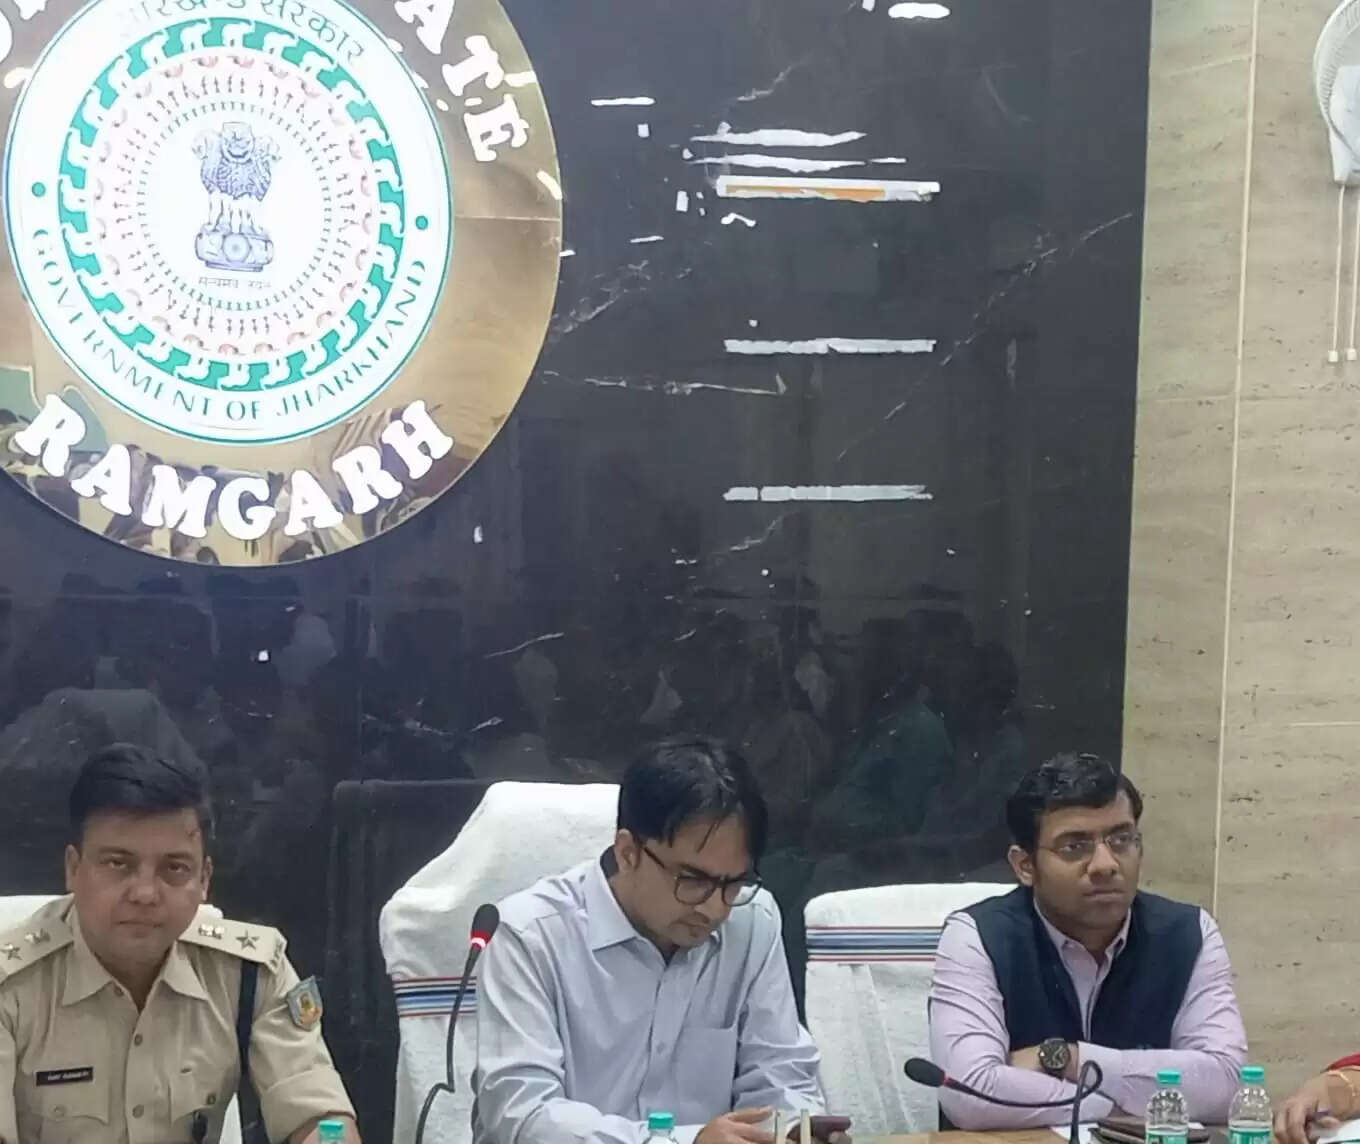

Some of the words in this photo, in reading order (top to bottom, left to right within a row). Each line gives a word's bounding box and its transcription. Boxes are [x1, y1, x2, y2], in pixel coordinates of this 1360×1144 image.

[33, 229, 213, 416] GOVERNMENT
[226, 400, 260, 421] OF
[276, 261, 426, 415] JHARKHAND
[14, 394, 454, 540] RAMGARH
